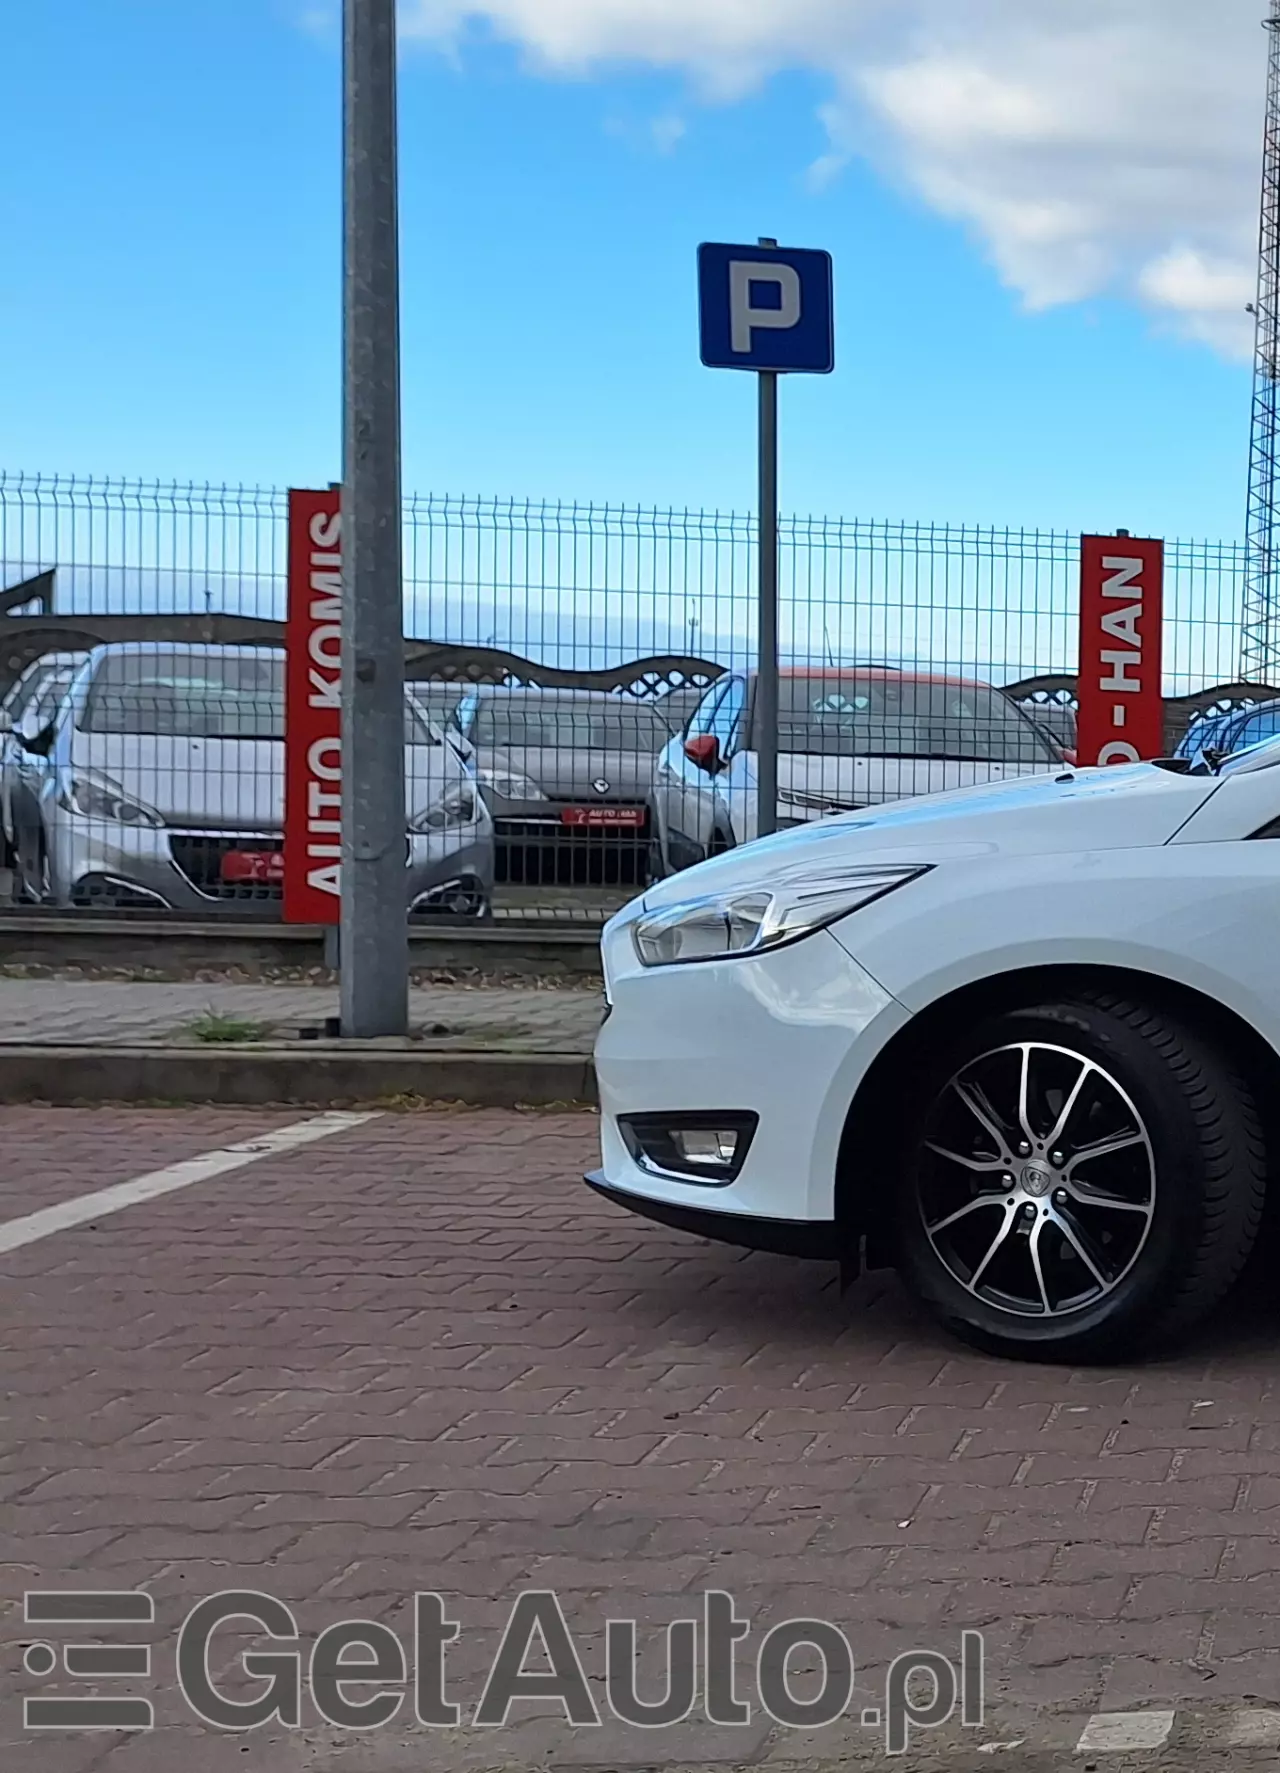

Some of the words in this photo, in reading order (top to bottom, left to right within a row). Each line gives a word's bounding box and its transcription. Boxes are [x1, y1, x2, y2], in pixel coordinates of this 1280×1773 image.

[729, 260, 801, 353] P
[307, 511, 344, 708] KOMIS
[307, 736, 343, 897] AUTO
